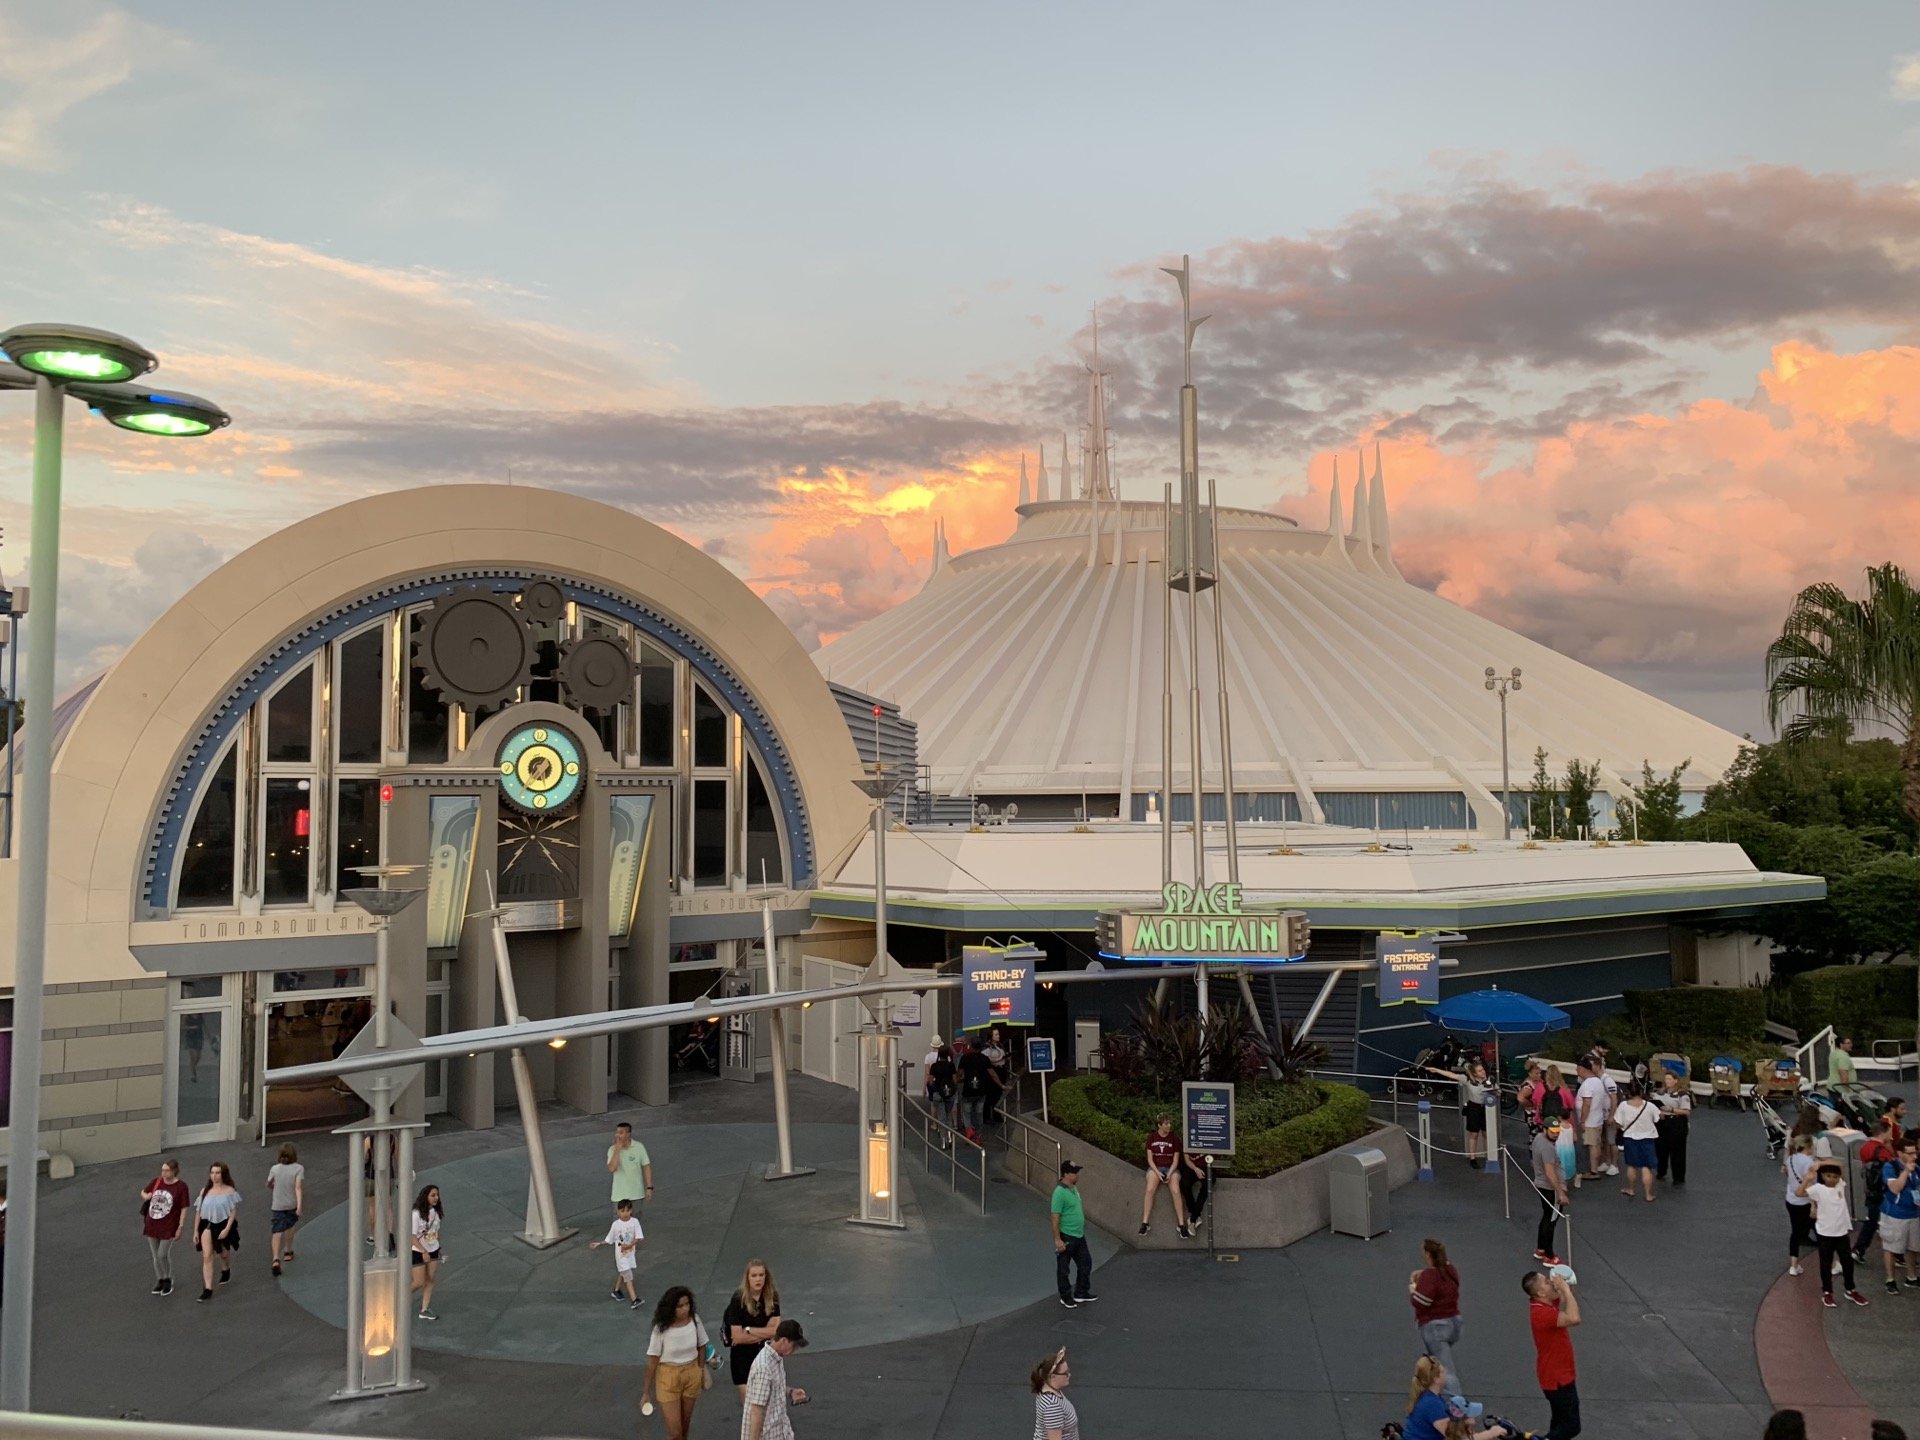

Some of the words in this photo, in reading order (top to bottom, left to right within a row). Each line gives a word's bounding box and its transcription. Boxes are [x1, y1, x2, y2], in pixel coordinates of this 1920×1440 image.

[1162, 876, 1243, 914] SPACE
[1132, 915, 1279, 953] MOUNTAIN
[1383, 952, 1436, 963] FASTPASS+
[1391, 963, 1429, 972] ENTRANCE
[971, 968, 1026, 982] STAND-BY
[976, 980, 1021, 991] ENTRANCE
